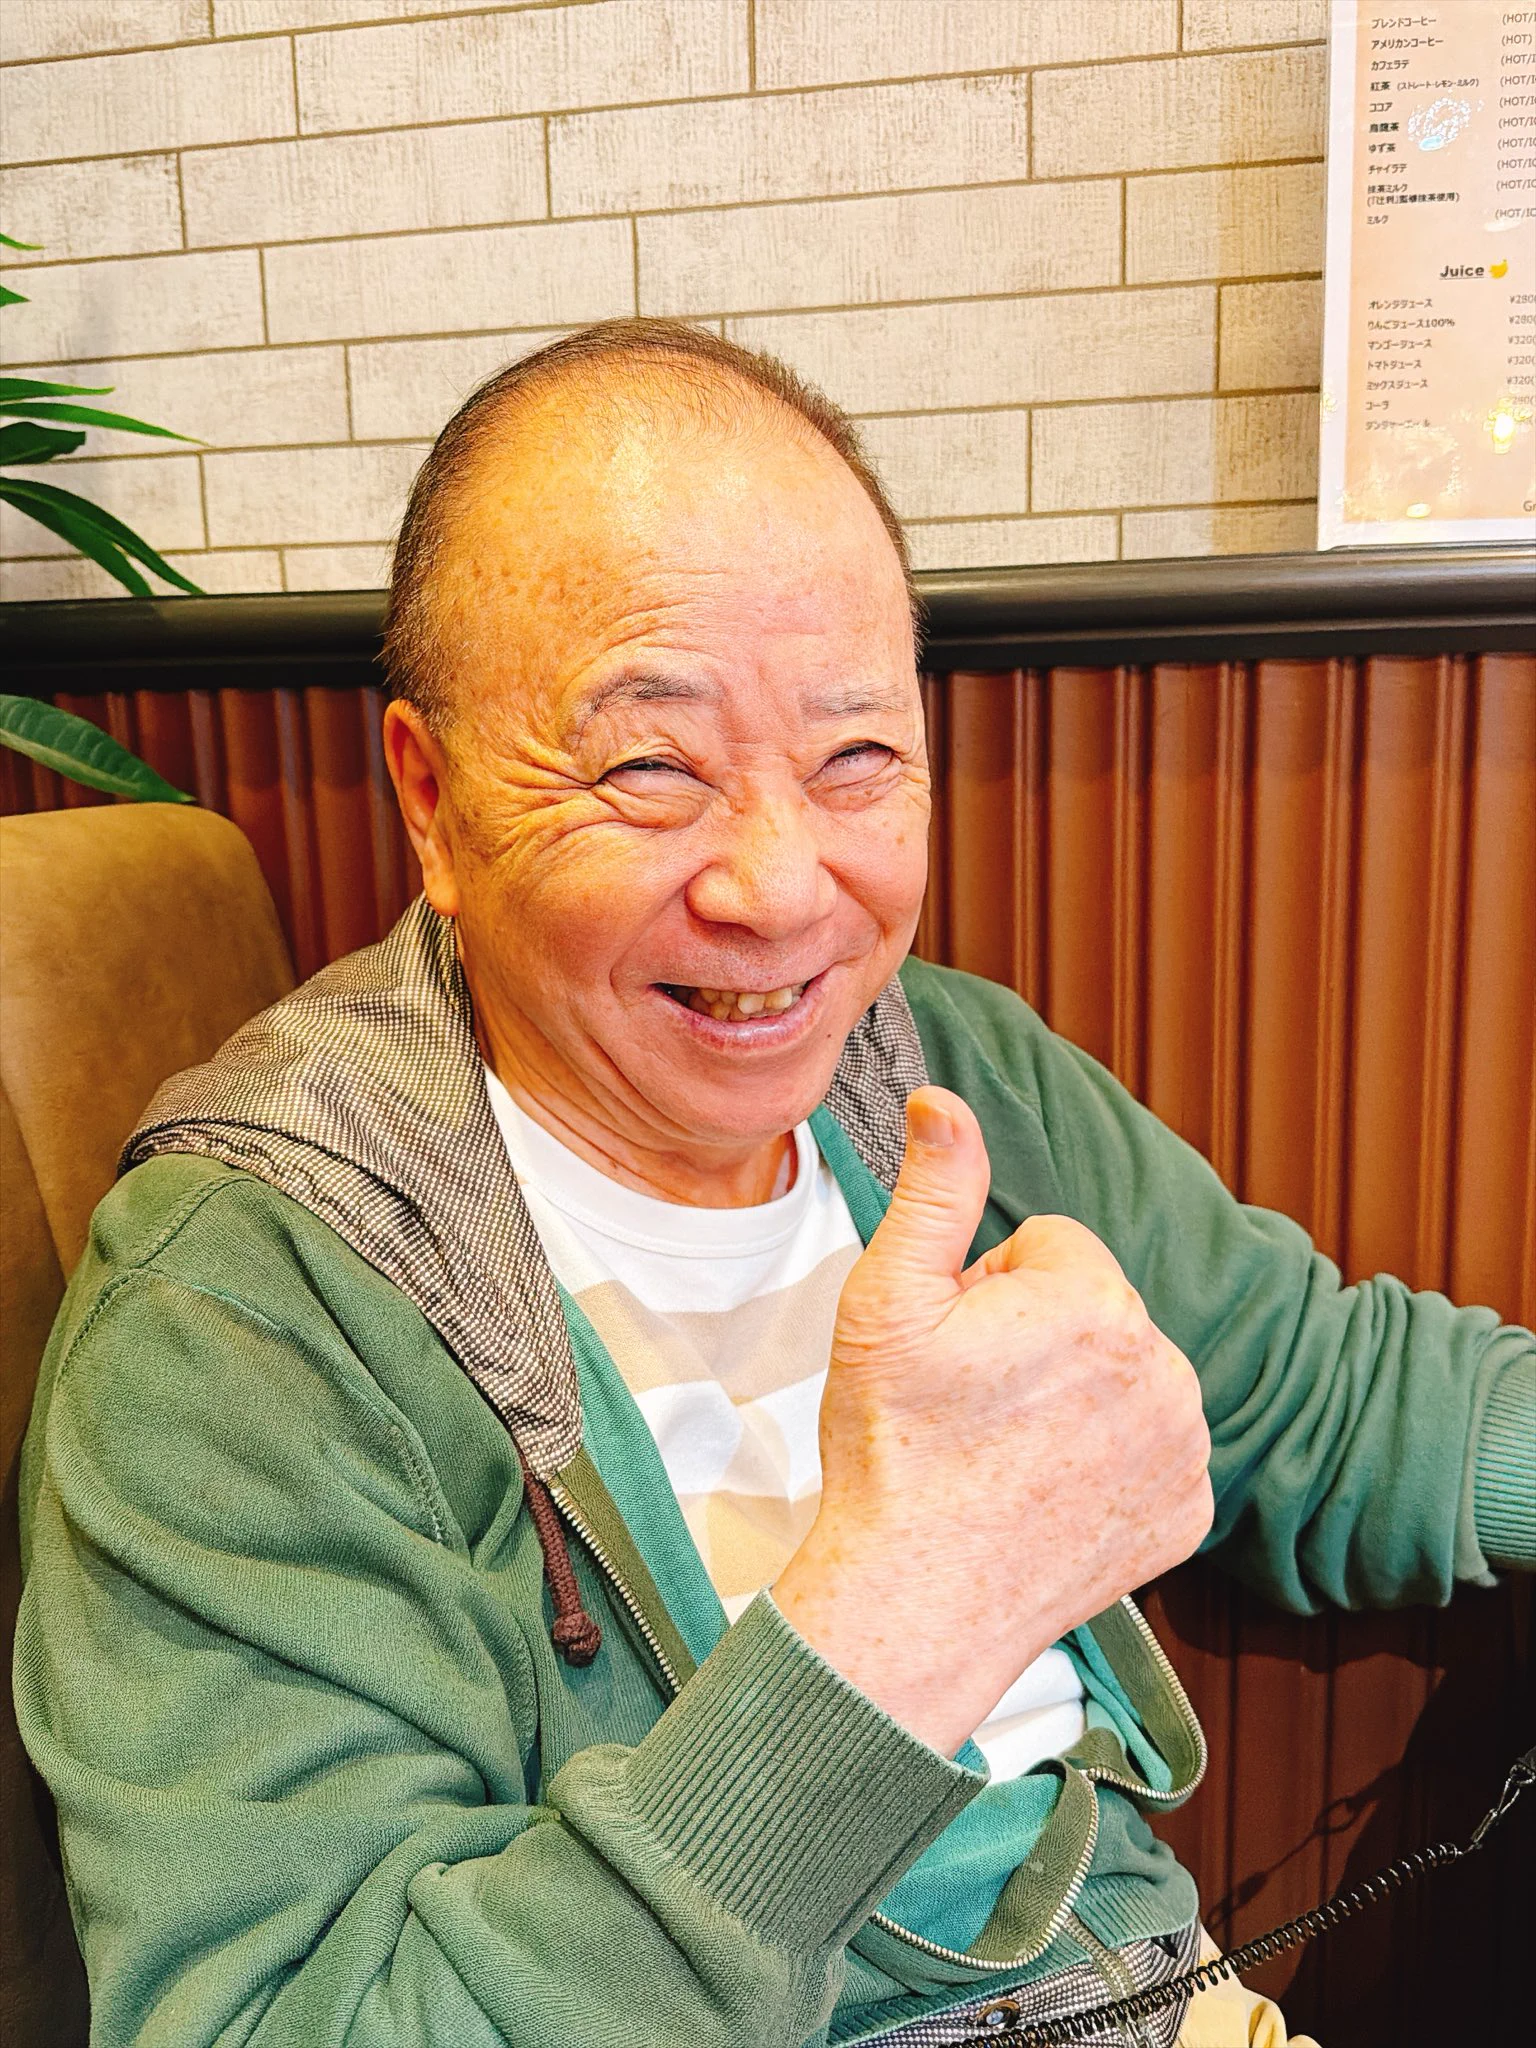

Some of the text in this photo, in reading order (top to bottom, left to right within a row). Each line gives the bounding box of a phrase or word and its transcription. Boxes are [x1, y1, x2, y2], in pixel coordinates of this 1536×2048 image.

[1371, 16, 1437, 30] ブレンドコーヒー
[1371, 37, 1444, 50] アメリカンコーヒー
[1501, 33, 1533, 47] (HOT)
[1370, 59, 1410, 72] カフェラテ
[1370, 81, 1391, 92] 紅茶
[1369, 102, 1394, 113] ココア
[1368, 142, 1396, 153] ゆず茶
[1368, 163, 1408, 175] チャイラテ
[1367, 215, 1389, 225] ミルク
[1440, 265, 1485, 278] Juice
[1365, 400, 1390, 411] コーラ
